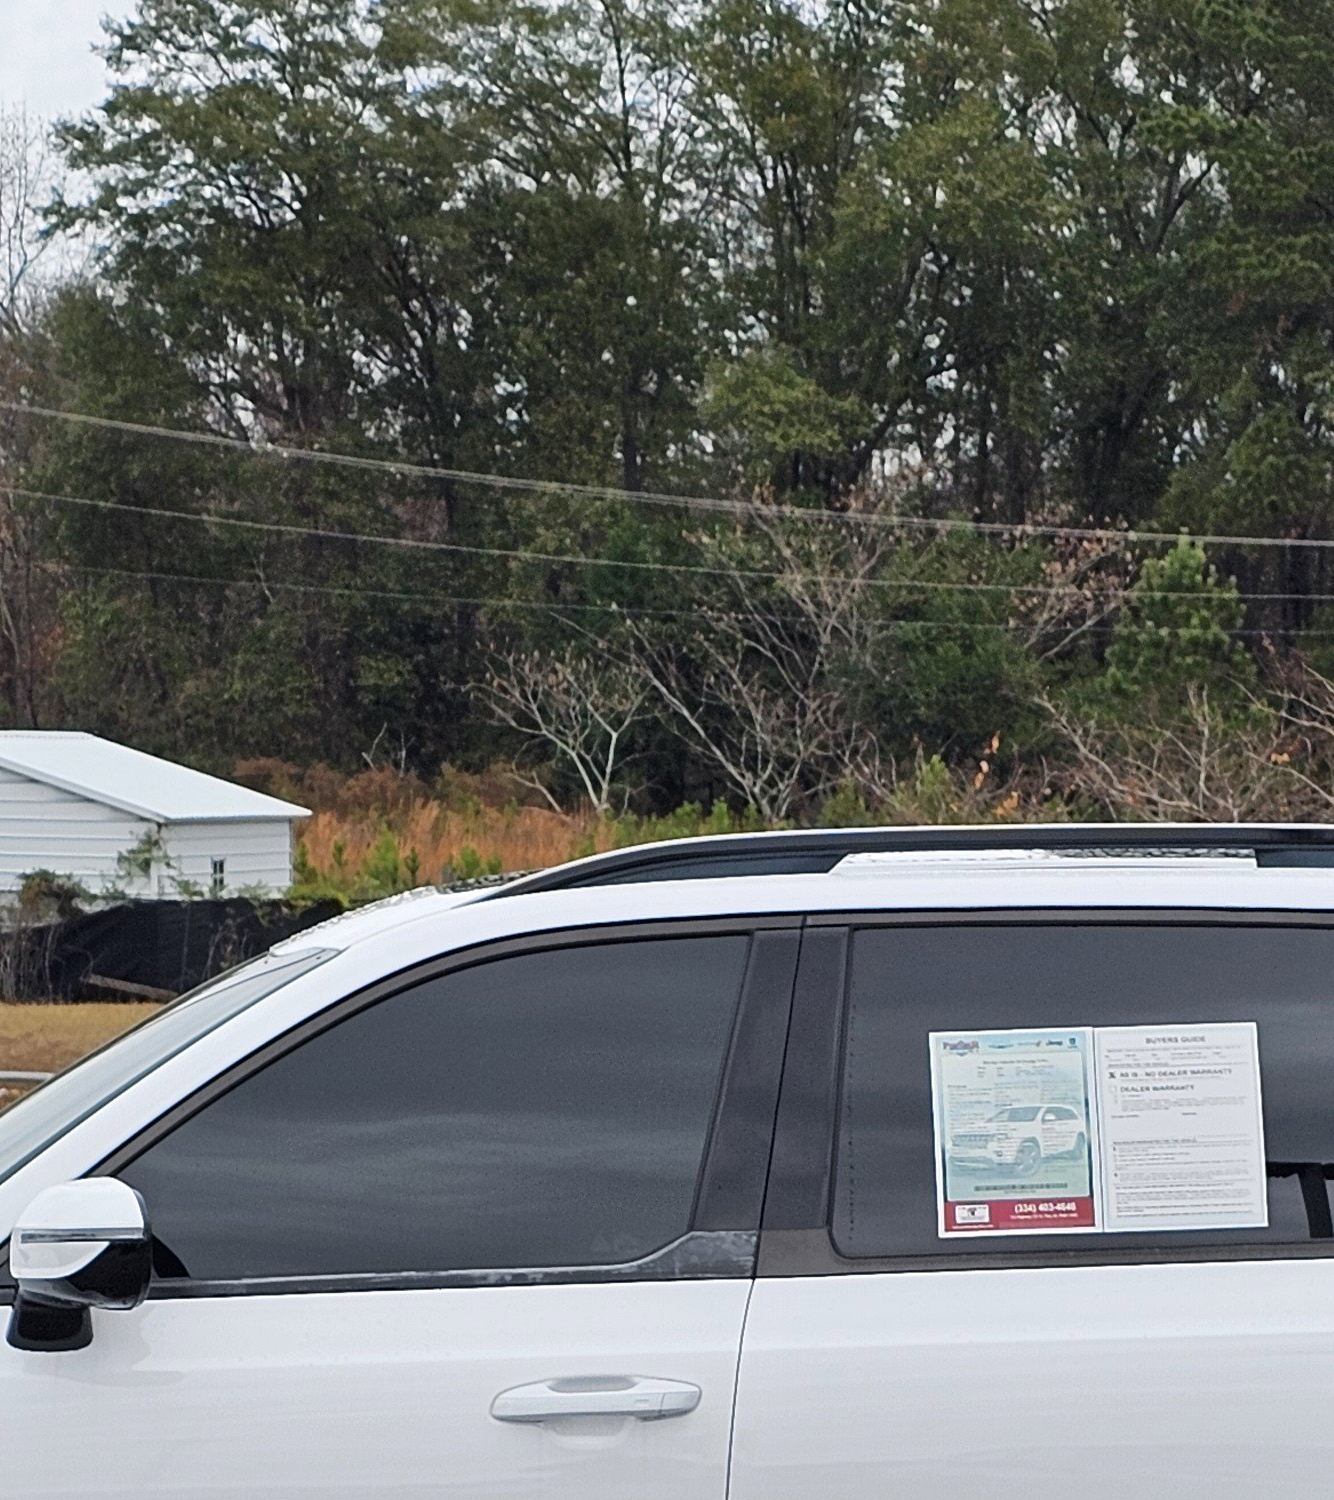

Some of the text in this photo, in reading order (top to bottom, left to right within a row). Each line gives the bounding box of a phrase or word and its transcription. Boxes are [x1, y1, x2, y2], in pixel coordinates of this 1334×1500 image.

[1145, 1035, 1206, 1044] BUYERS GUIDE
[1158, 1069, 1188, 1077] DEALER
[1190, 1068, 1233, 1076] WARRANTY
[1120, 1084, 1195, 1093] DEALER WARRANTY
